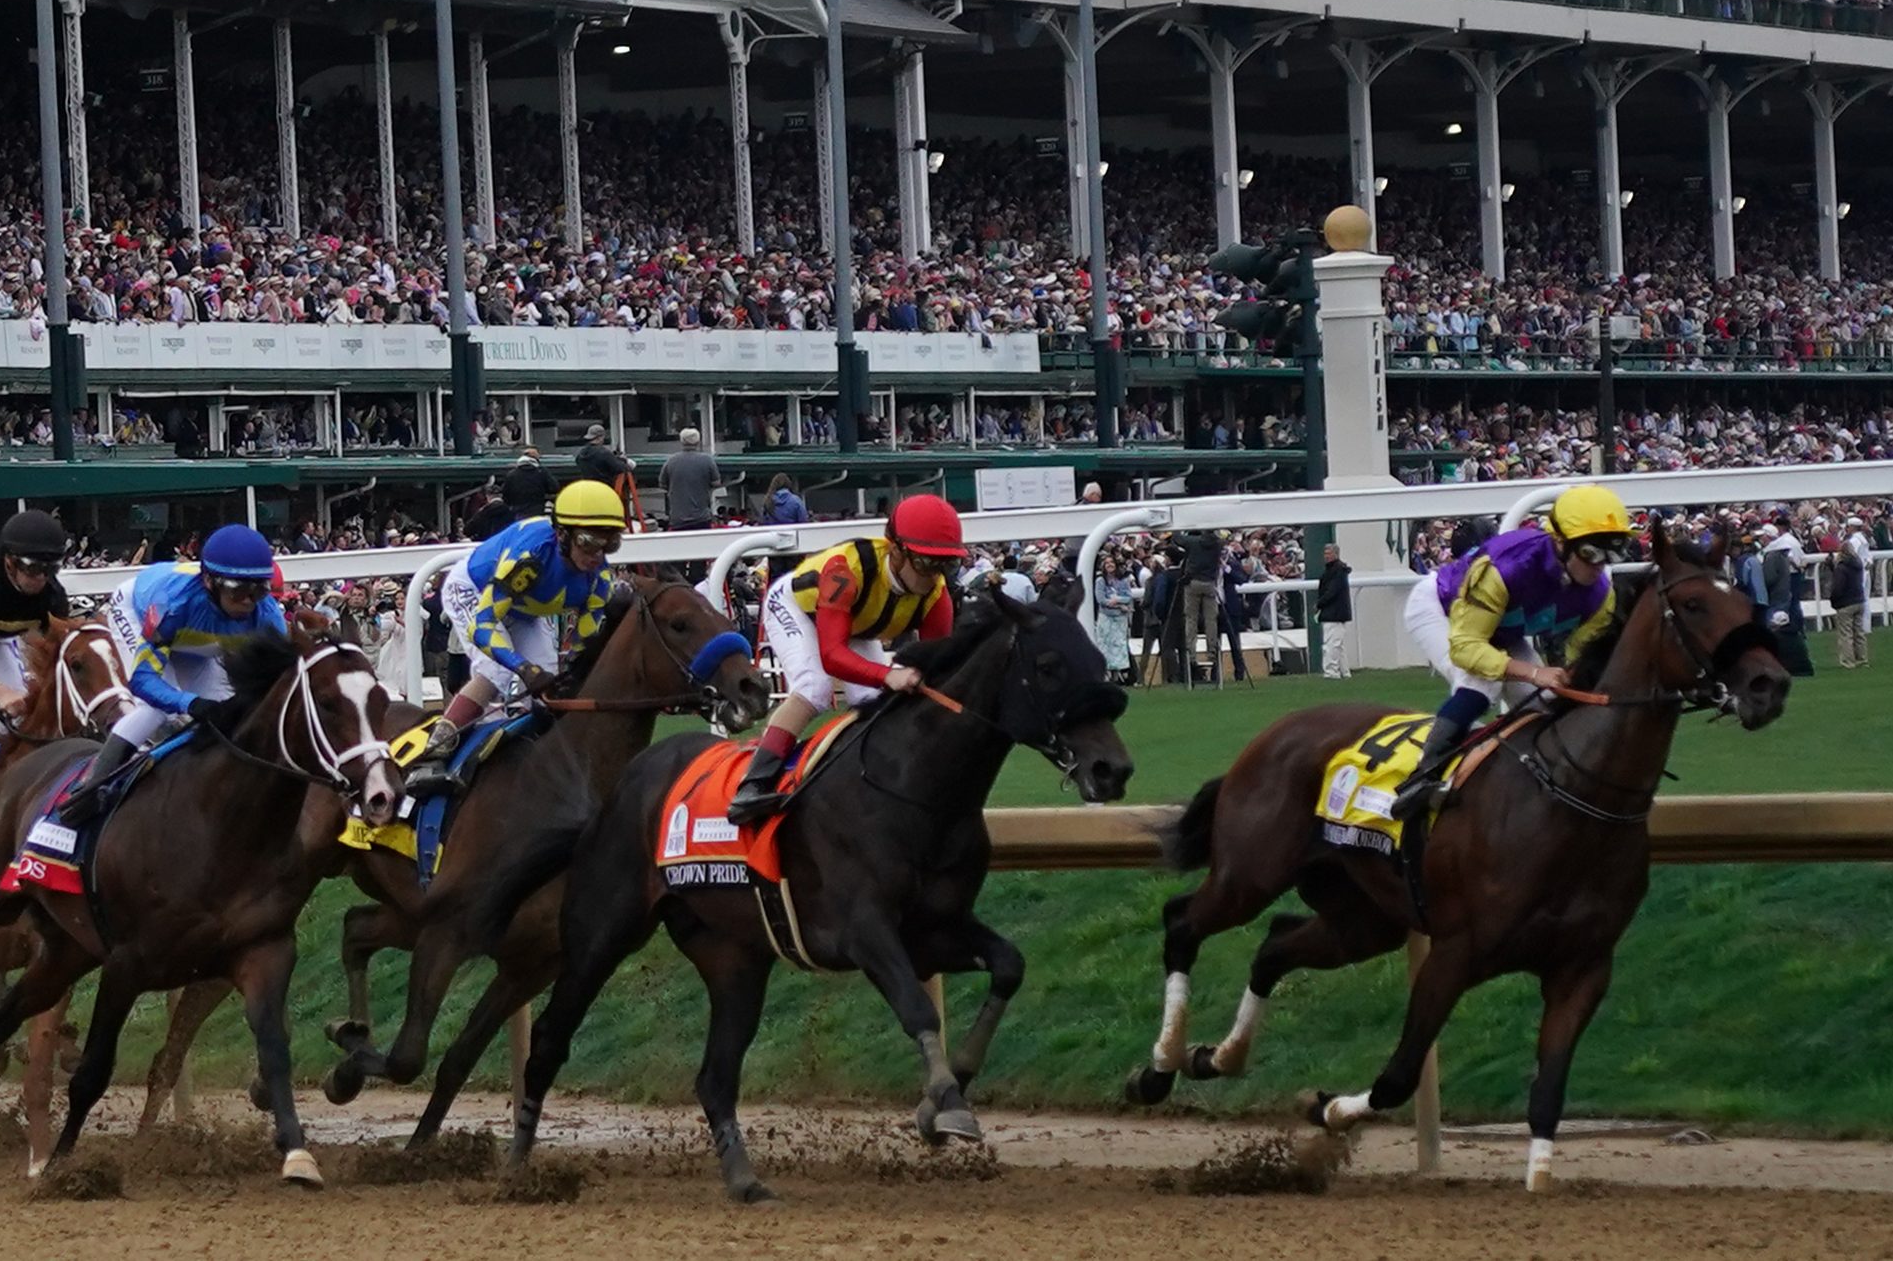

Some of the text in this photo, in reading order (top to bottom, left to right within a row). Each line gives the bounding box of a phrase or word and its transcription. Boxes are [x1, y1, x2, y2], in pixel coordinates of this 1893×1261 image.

[146, 73, 164, 85] 318
[528, 335, 569, 362] DOWNS
[1373, 321, 1385, 431] FINISH
[511, 567, 538, 593] 6
[828, 574, 850, 603] 7
[665, 863, 750, 886] CROWN PRIDE
